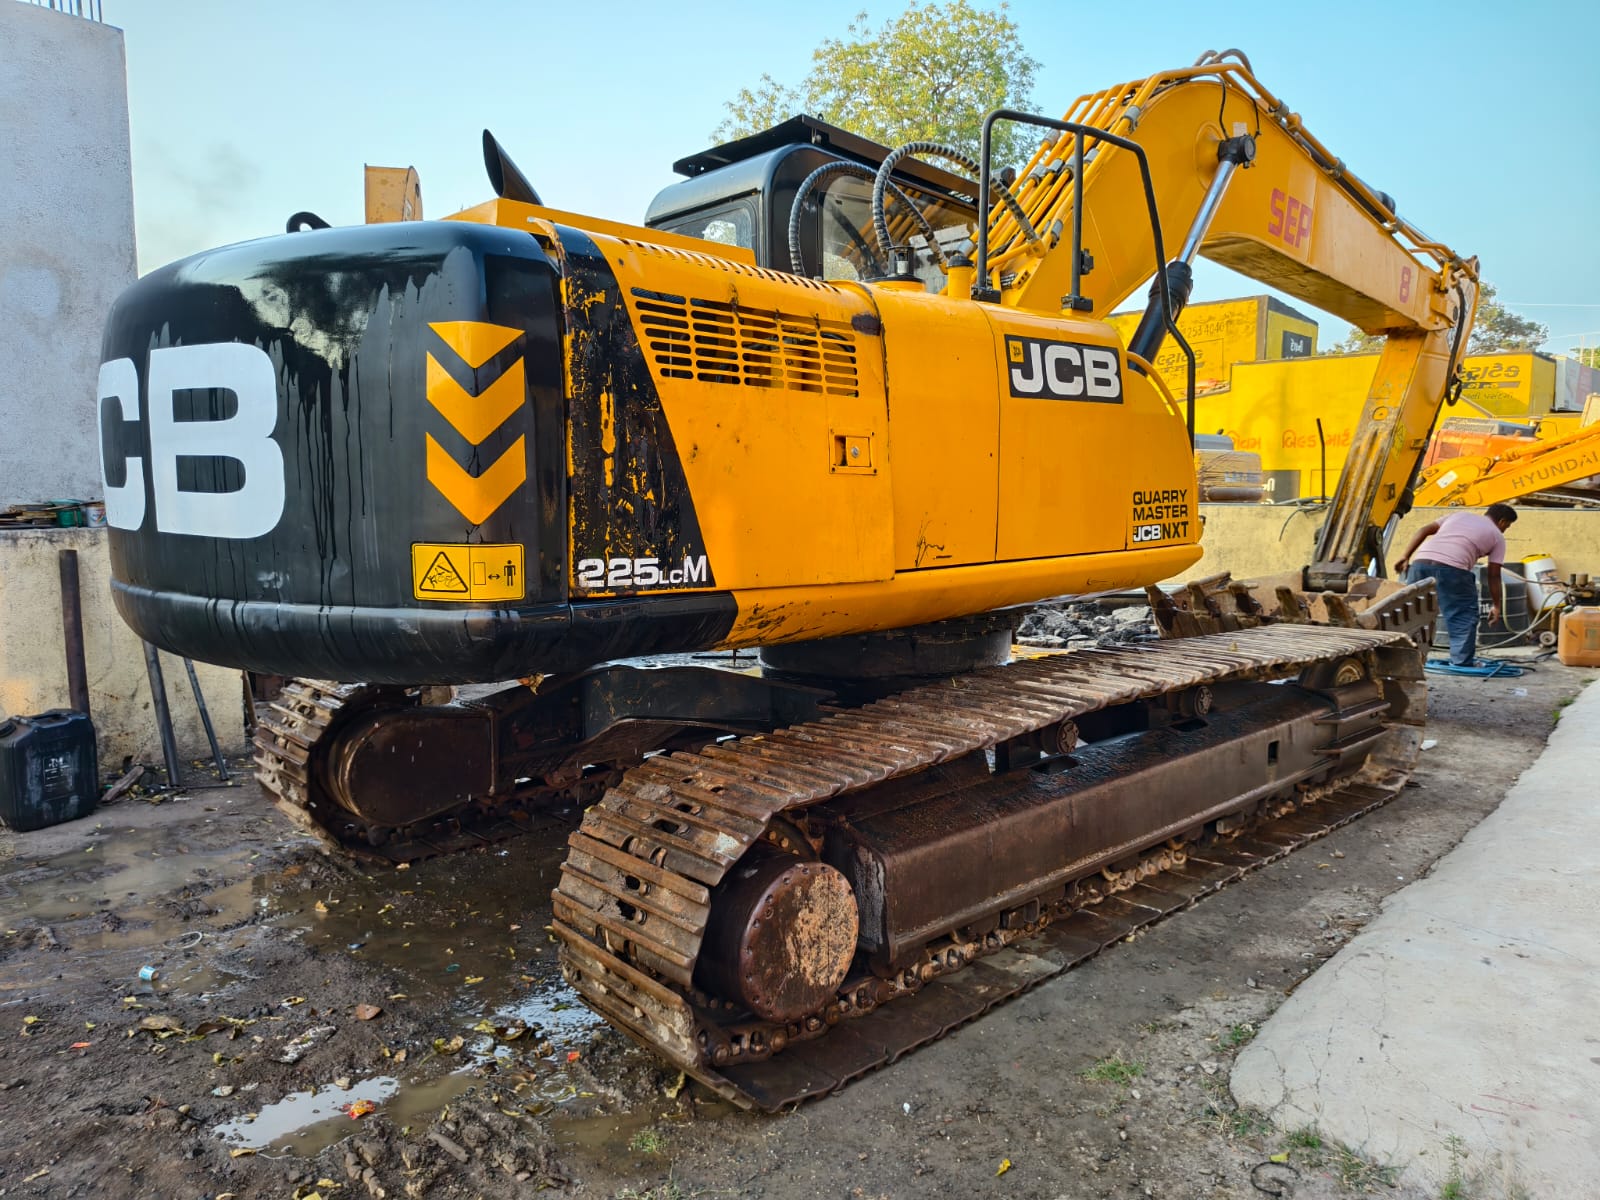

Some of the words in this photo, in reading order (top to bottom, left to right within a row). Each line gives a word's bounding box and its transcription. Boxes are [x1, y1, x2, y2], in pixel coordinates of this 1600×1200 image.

[1268, 187, 1313, 249] SEP
[1400, 266, 1411, 303] 8
[1011, 342, 1121, 398] JCB
[97, 343, 286, 539] CB
[1511, 450, 1599, 490] HYUNDAI
[1133, 489, 1188, 505] QUARRY
[1133, 504, 1188, 521] MASTER
